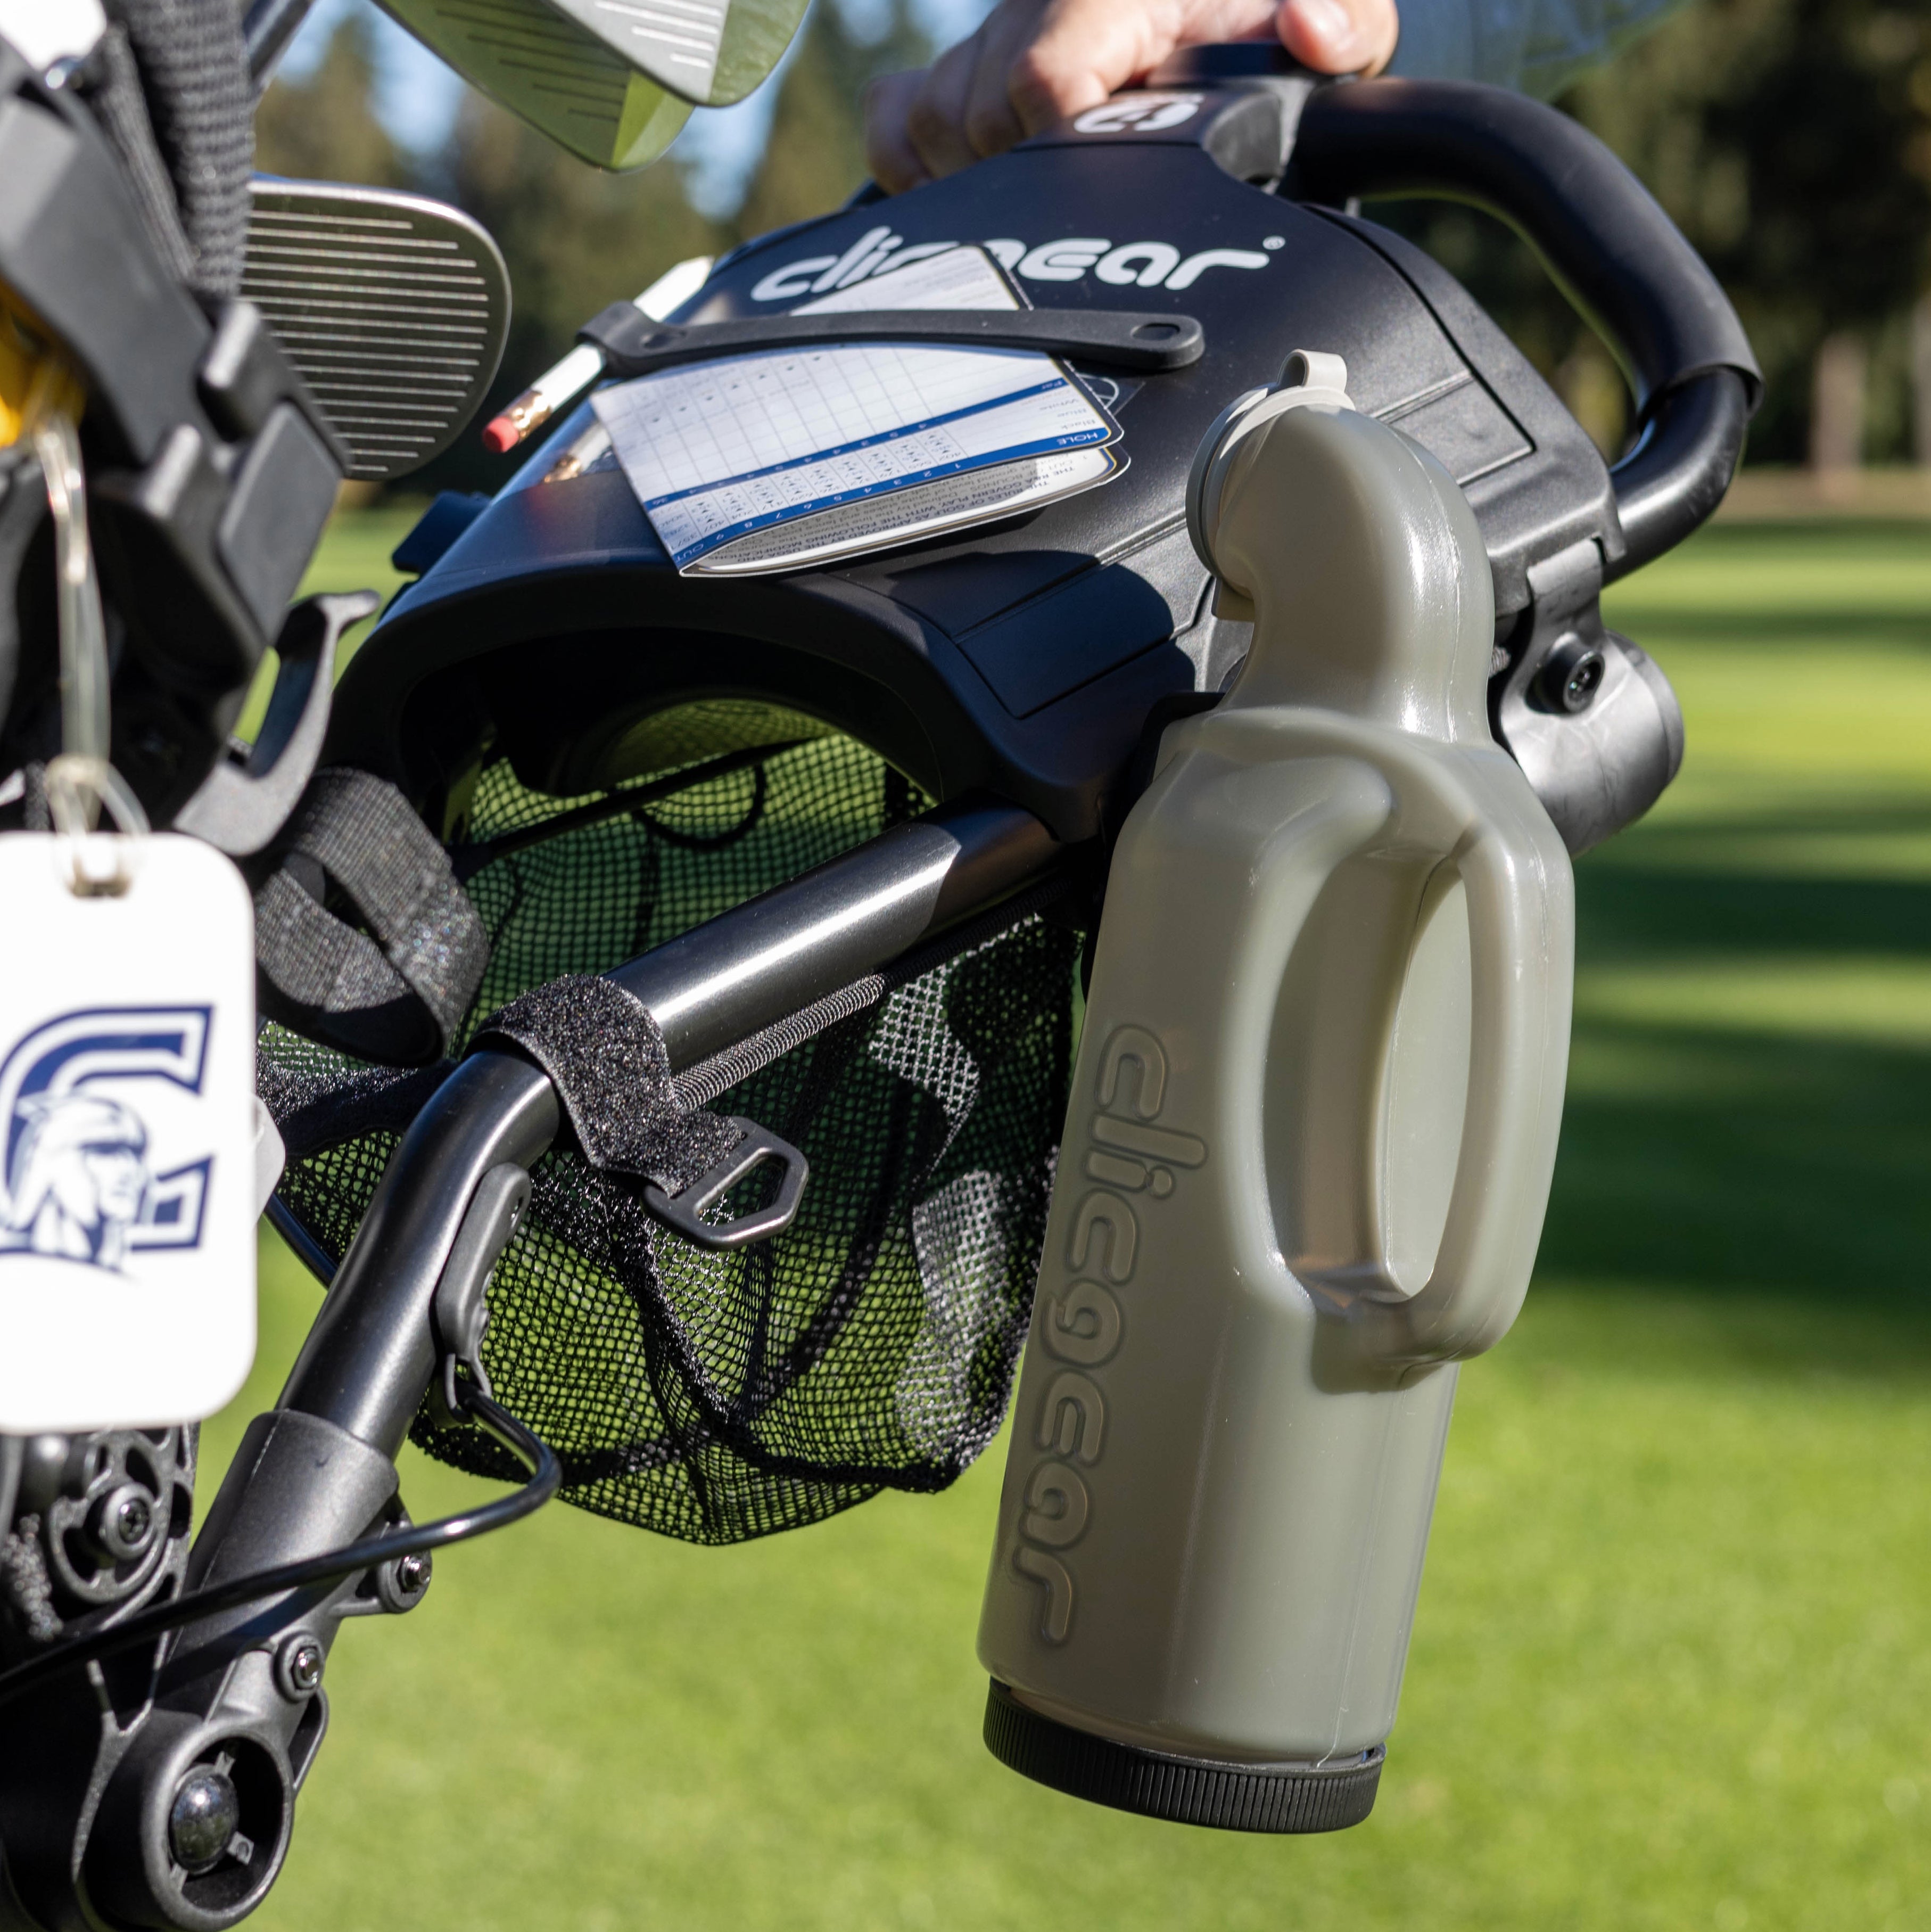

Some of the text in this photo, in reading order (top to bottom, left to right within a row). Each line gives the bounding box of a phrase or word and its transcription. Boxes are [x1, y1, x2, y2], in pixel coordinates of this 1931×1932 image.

[1062, 418, 1095, 430] Black
[1058, 432, 1097, 446] HOLE
[977, 468, 1017, 482] ground
[1056, 466, 1073, 475] THE
[948, 480, 975, 491] level
[970, 474, 1023, 491] BOUNDS
[1028, 481, 1047, 489] THE
[972, 482, 1021, 499] GOVERN
[988, 488, 1023, 500] RULES
[901, 492, 931, 504] white
[913, 491, 958, 507] Defined
[863, 502, 898, 514] stakes
[905, 506, 936, 517] WITH
[934, 504, 965, 515] GOLF
[839, 513, 860, 522] and
[852, 515, 872, 524] line
[883, 514, 902, 523] THE
[704, 520, 724, 533] 407
[799, 522, 849, 538] between
[805, 519, 836, 530] fence
[848, 517, 911, 538] APPROVED
[806, 521, 877, 542] FOLLOWING
[738, 541, 775, 552] course
[807, 540, 825, 549] THE
[675, 544, 704, 561] OUT
[768, 547, 801, 557] USGA
[1012, 1023, 1208, 1645] clicgear
